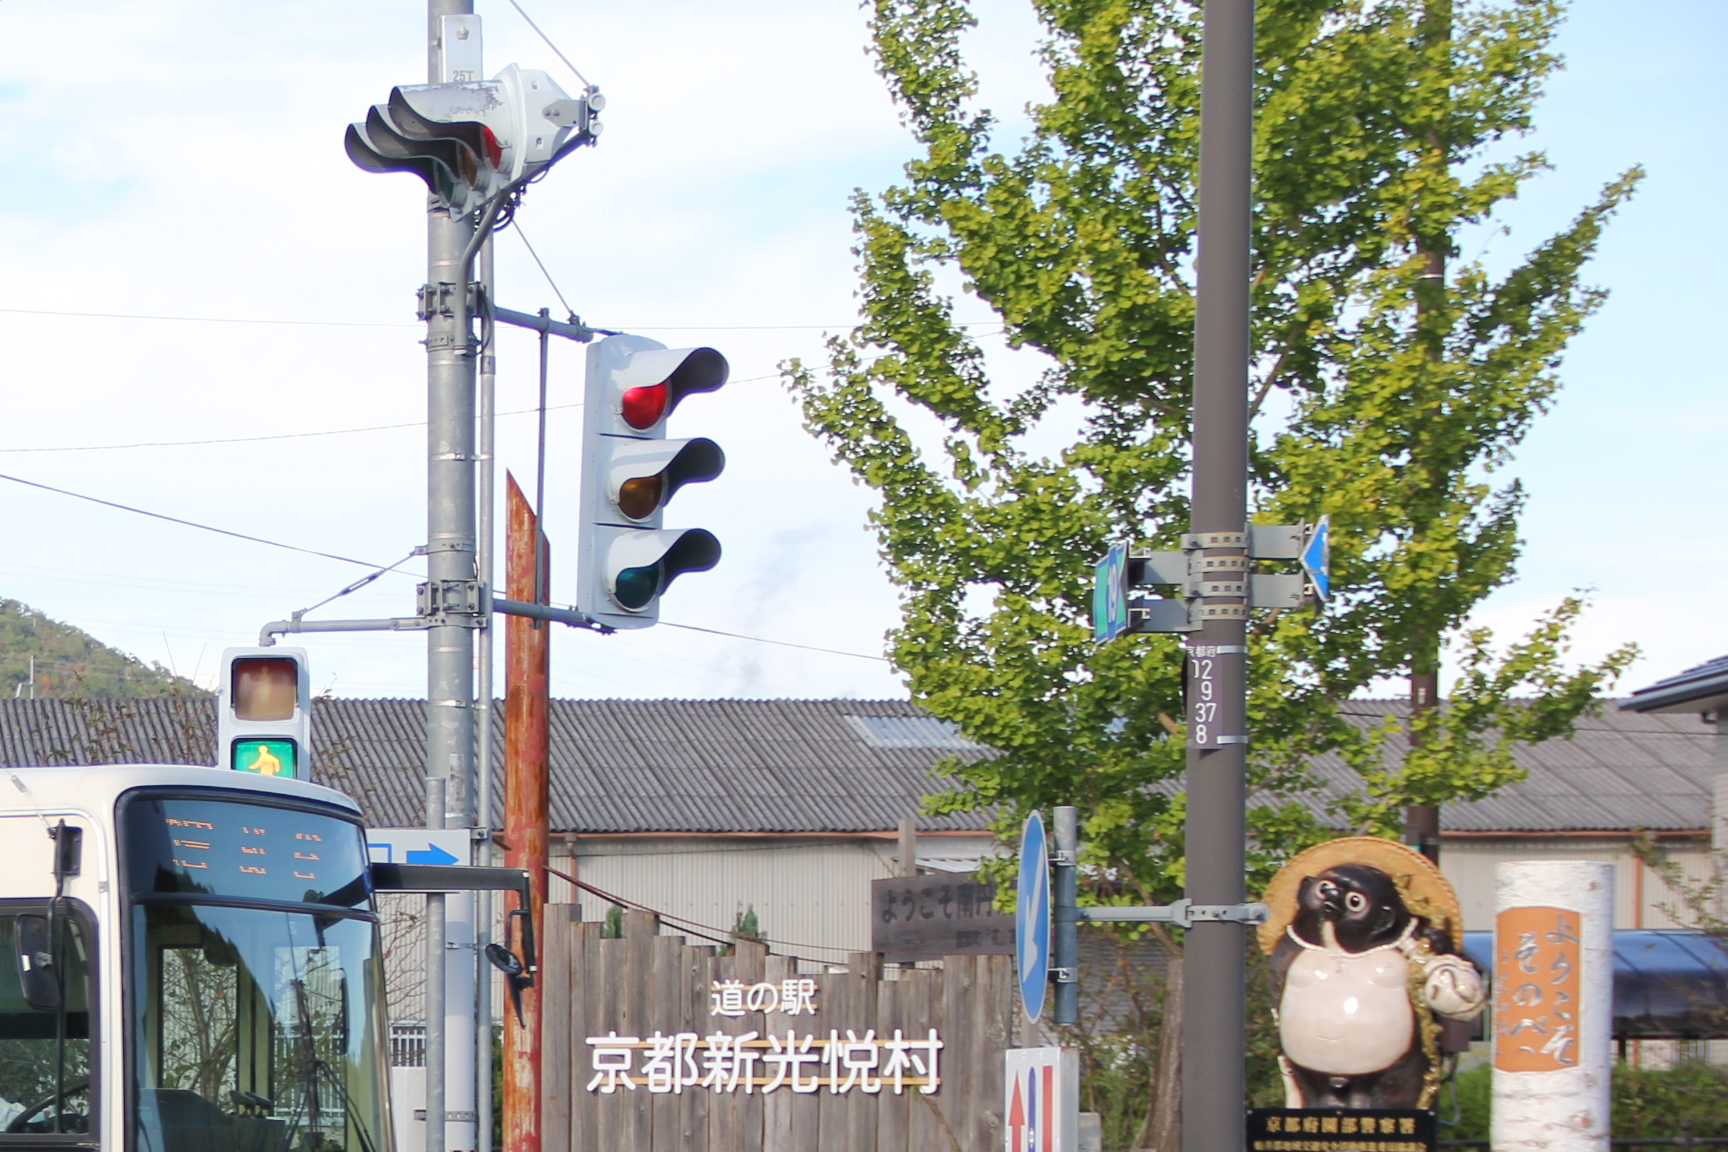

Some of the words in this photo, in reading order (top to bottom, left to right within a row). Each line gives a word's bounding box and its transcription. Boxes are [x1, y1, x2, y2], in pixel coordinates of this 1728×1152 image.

[1191, 660, 1212, 680] 12
[1201, 682, 1212, 701] 9
[1195, 703, 1217, 723] 37
[1195, 724, 1208, 745] 8
[711, 979, 816, 1017] 道の駅
[585, 1028, 944, 1095] 京都新光悦村
